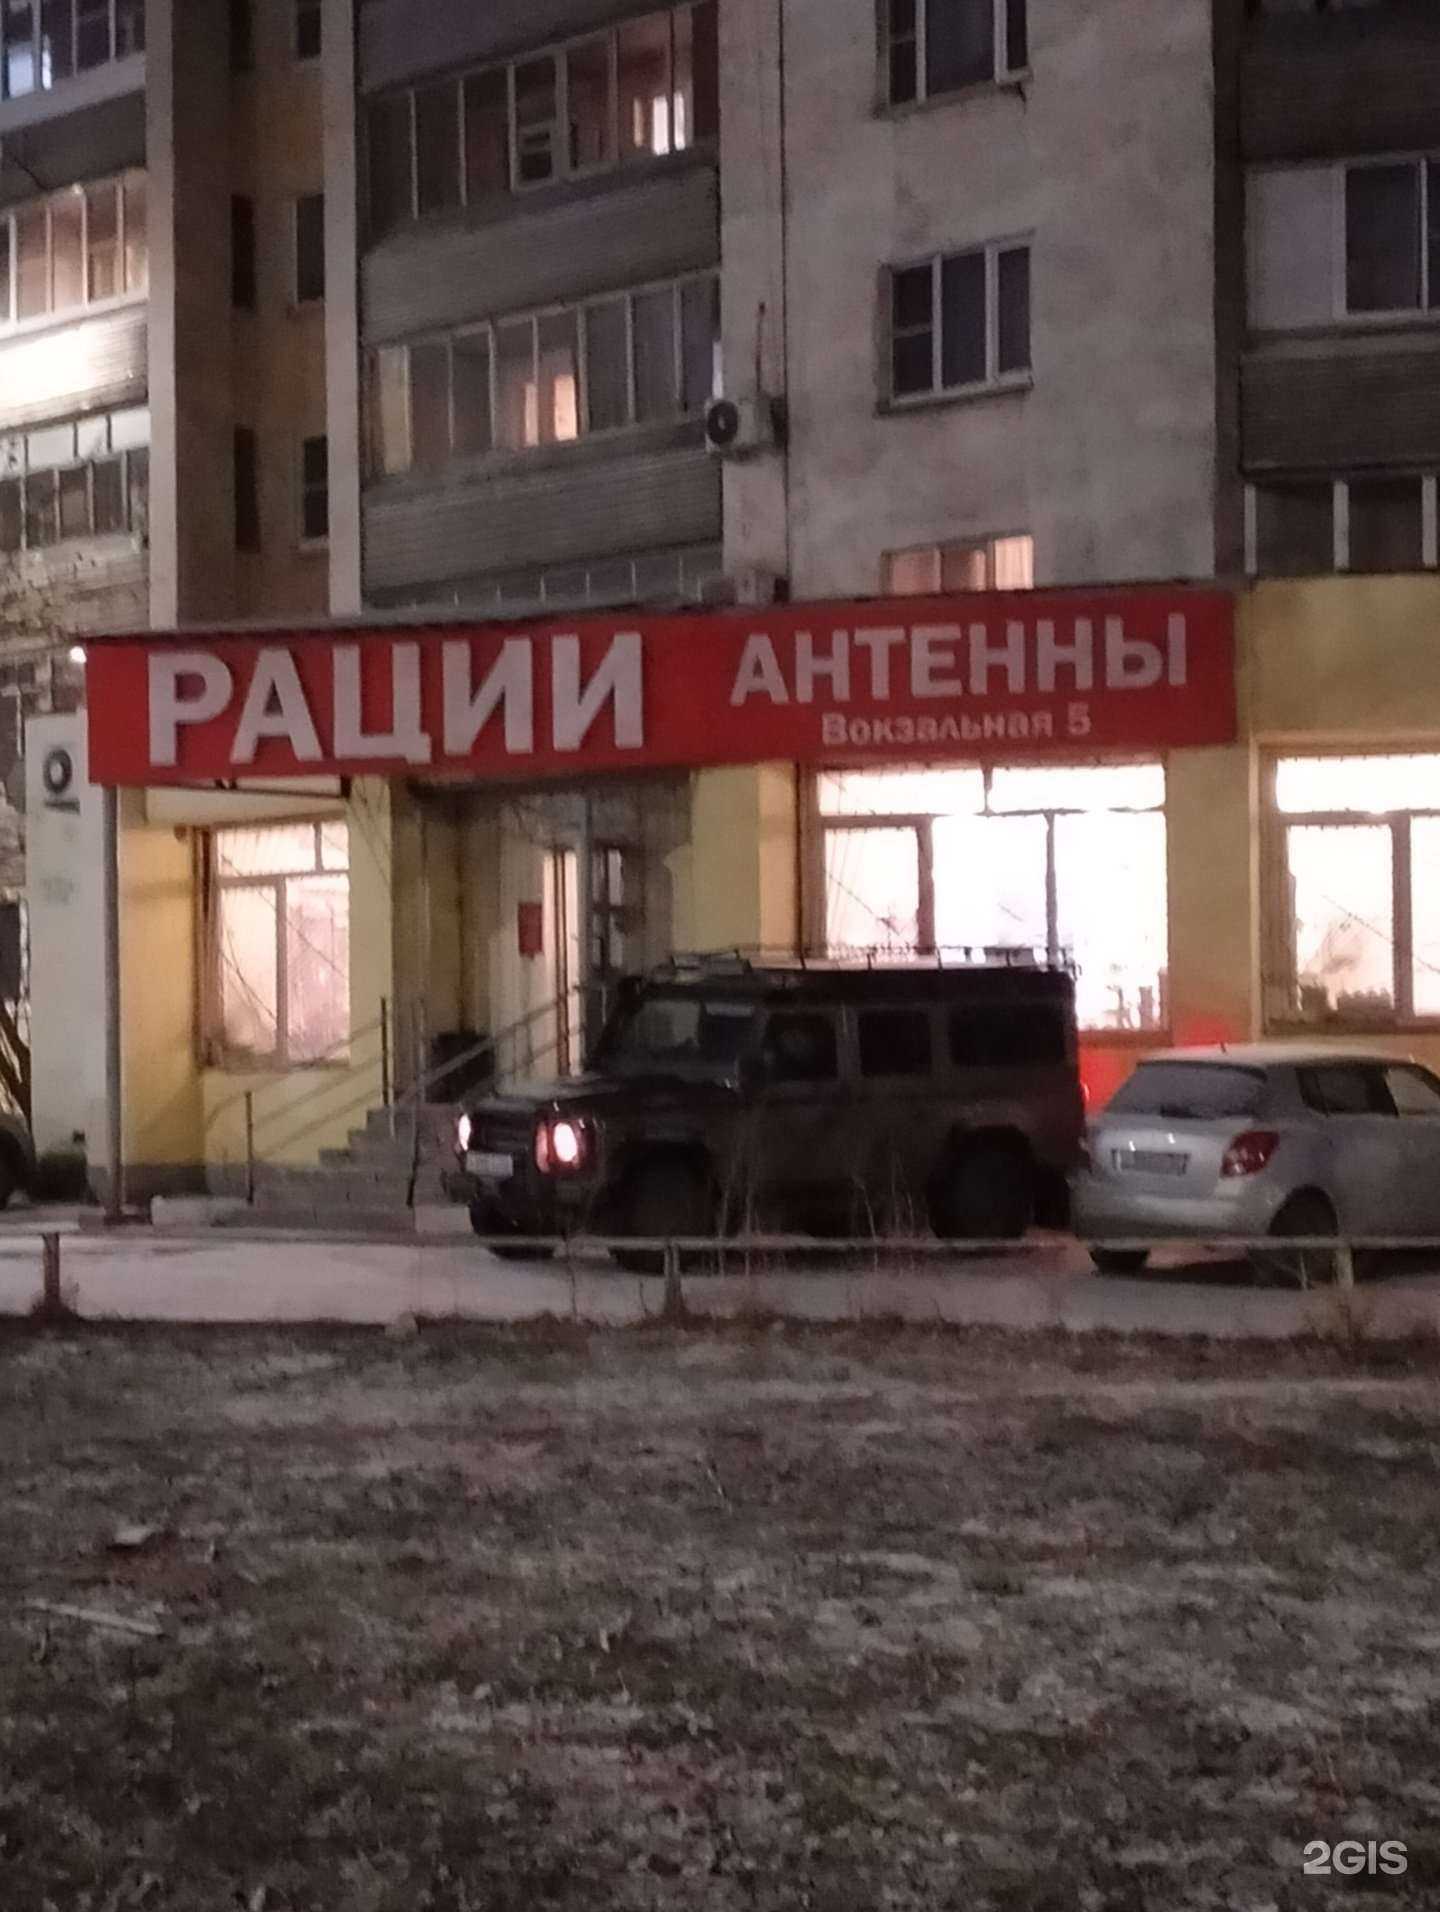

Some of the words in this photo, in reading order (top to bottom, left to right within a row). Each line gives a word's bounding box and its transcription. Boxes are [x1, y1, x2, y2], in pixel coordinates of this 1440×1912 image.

[148, 631, 643, 767] РАЦИИ
[729, 613, 1188, 706] АНТЕННЫ
[821, 710, 1053, 746] Вокзальная
[1067, 703, 1092, 737] 5
